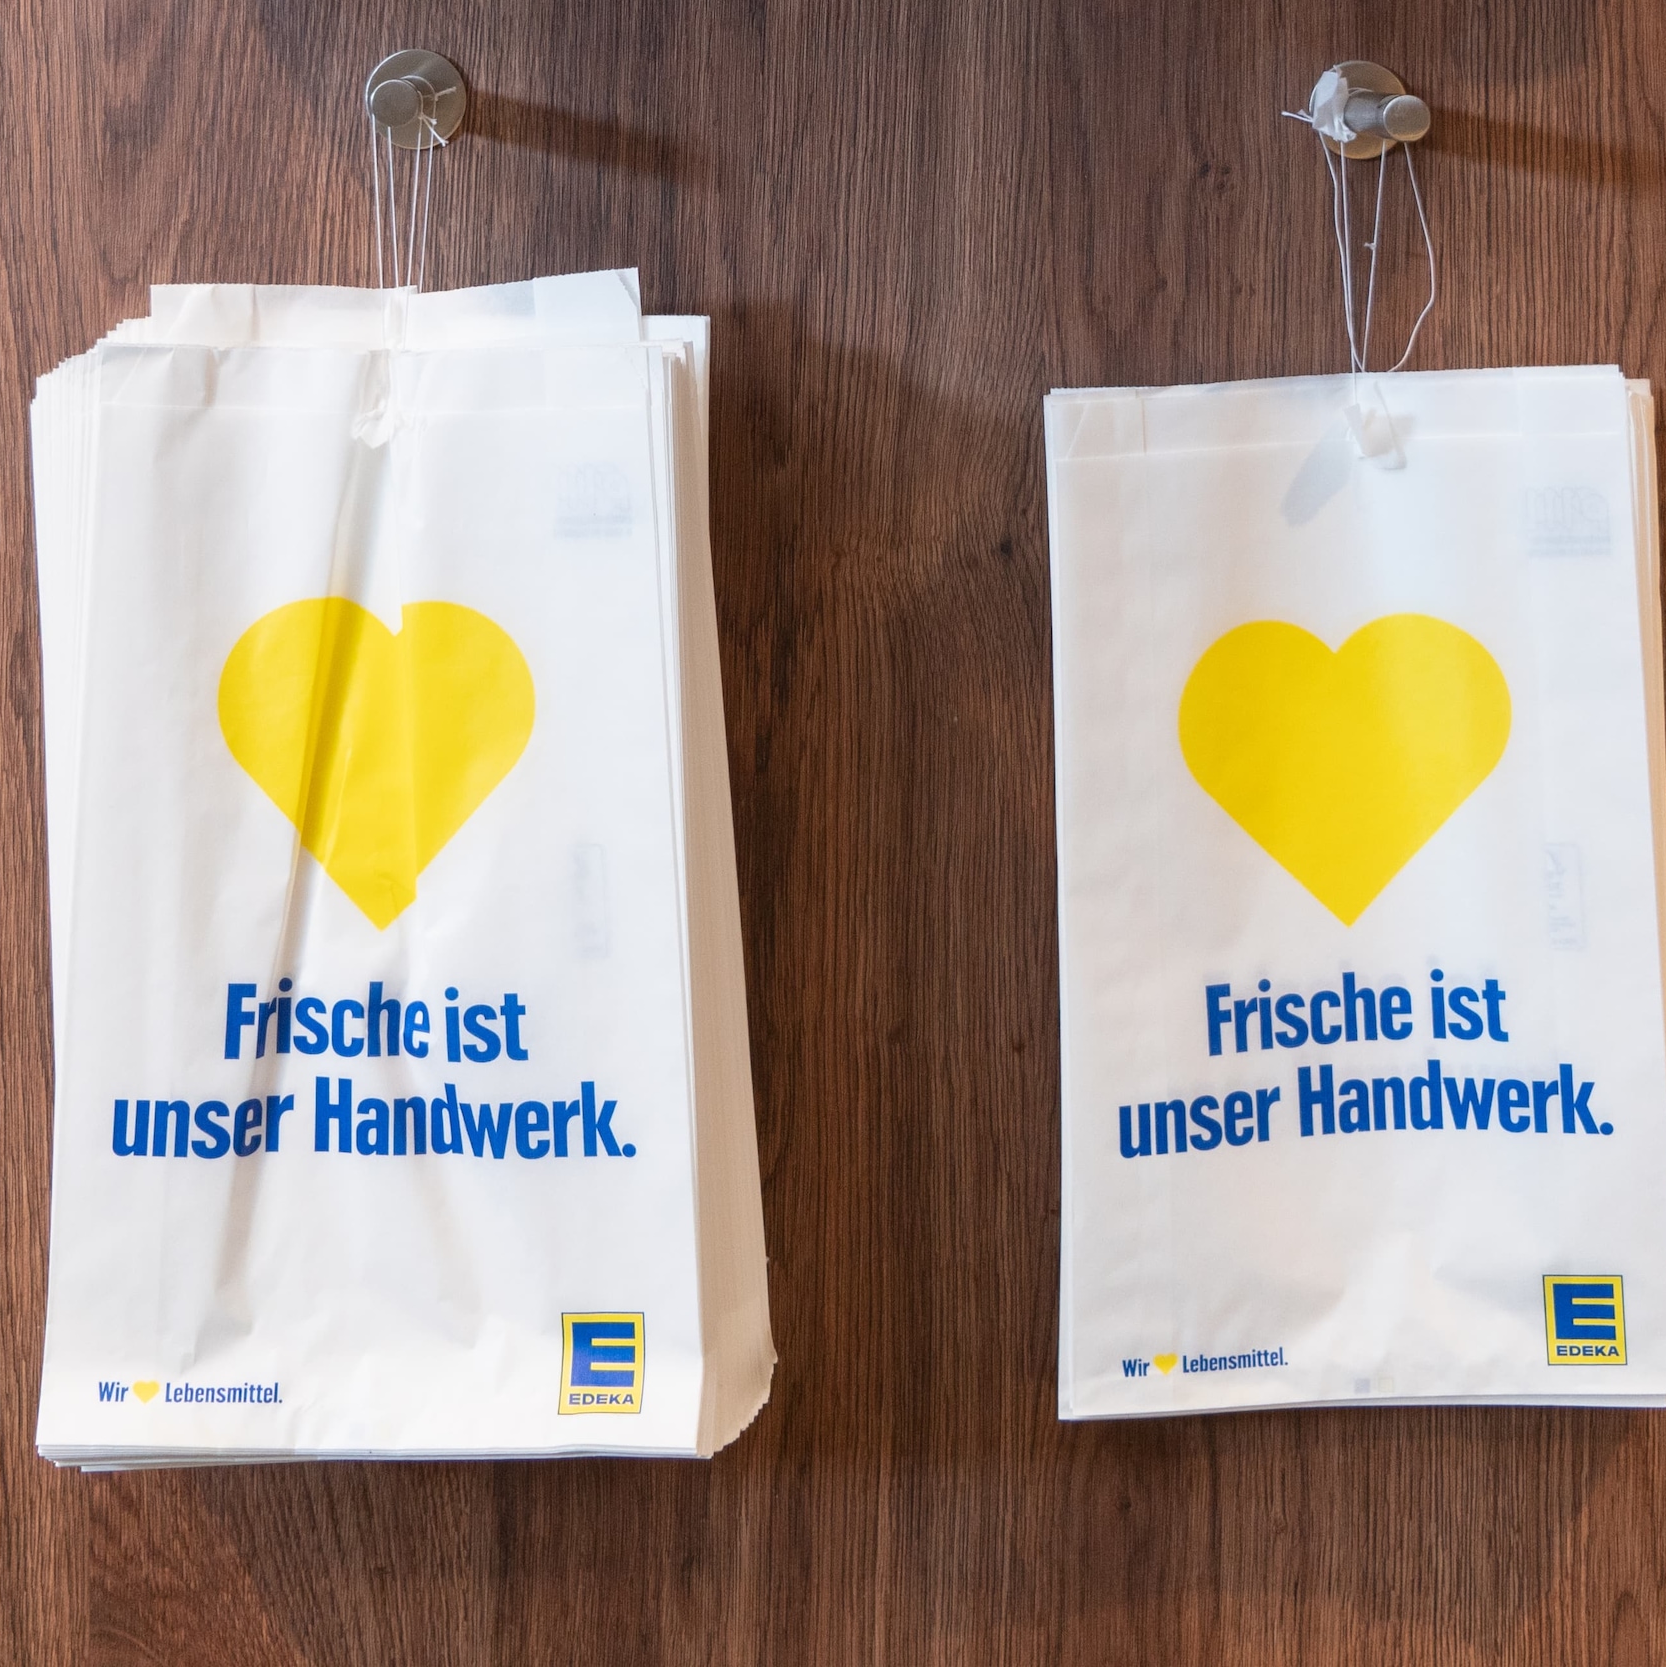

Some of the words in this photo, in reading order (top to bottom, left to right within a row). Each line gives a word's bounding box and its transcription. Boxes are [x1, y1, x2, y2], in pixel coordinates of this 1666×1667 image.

[224, 978, 430, 1060] Frische
[445, 987, 528, 1063] ist
[1205, 972, 1413, 1056] Frische
[1430, 968, 1509, 1042] ist
[112, 1094, 294, 1159] unser
[314, 1076, 636, 1159] Handwerk.
[1119, 1087, 1281, 1159] unser
[1298, 1059, 1614, 1137] Handwerk.
[1552, 1283, 1616, 1341] E
[571, 1322, 635, 1387] E
[1122, 1358, 1150, 1377] Wir
[1183, 1347, 1288, 1373] Lebensmittel.
[1556, 1345, 1620, 1358] EDEKA
[99, 1382, 128, 1401] Wir
[166, 1383, 282, 1403] Lebensmittel.
[569, 1393, 634, 1406] EDEKA
